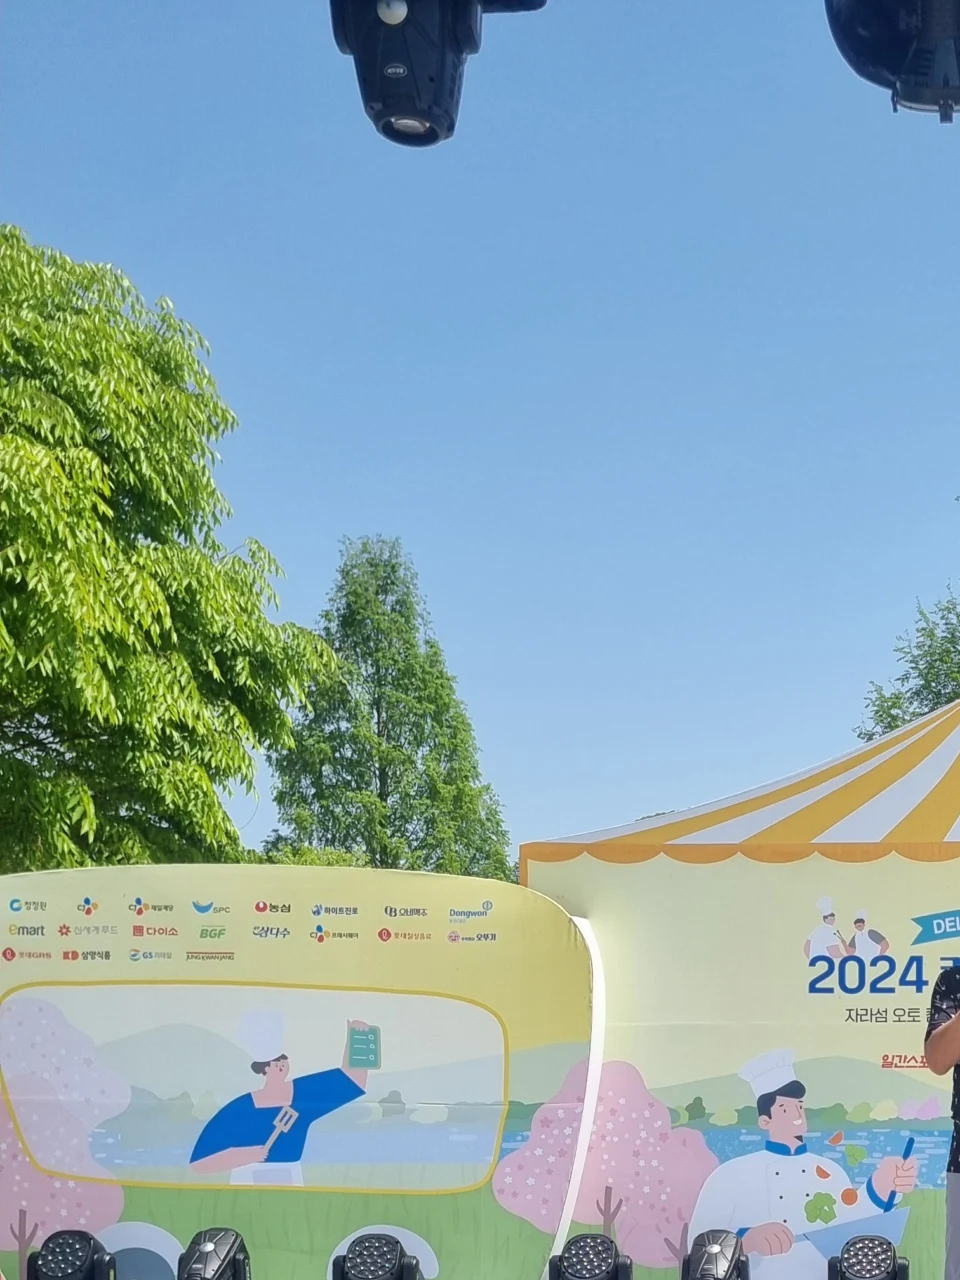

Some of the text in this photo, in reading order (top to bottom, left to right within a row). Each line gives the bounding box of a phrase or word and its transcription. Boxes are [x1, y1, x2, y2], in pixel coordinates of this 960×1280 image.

[24, 901, 47, 911] 청정원
[77, 904, 86, 912] CJ
[212, 906, 231, 914] SPC
[269, 903, 291, 913] 농심
[323, 906, 359, 915] 하이트진로
[449, 908, 488, 919] Dongwon
[8, 924, 45, 937] emart
[146, 927, 179, 936] 다이소
[199, 928, 226, 939] BGF
[259, 926, 291, 939] 삼다수
[475, 933, 497, 942] 오뚜기
[81, 951, 111, 960] 삼양식품
[808, 954, 929, 995] 2024
[844, 1008, 888, 1023] 자라섬
[892, 1008, 921, 1023] 오토
